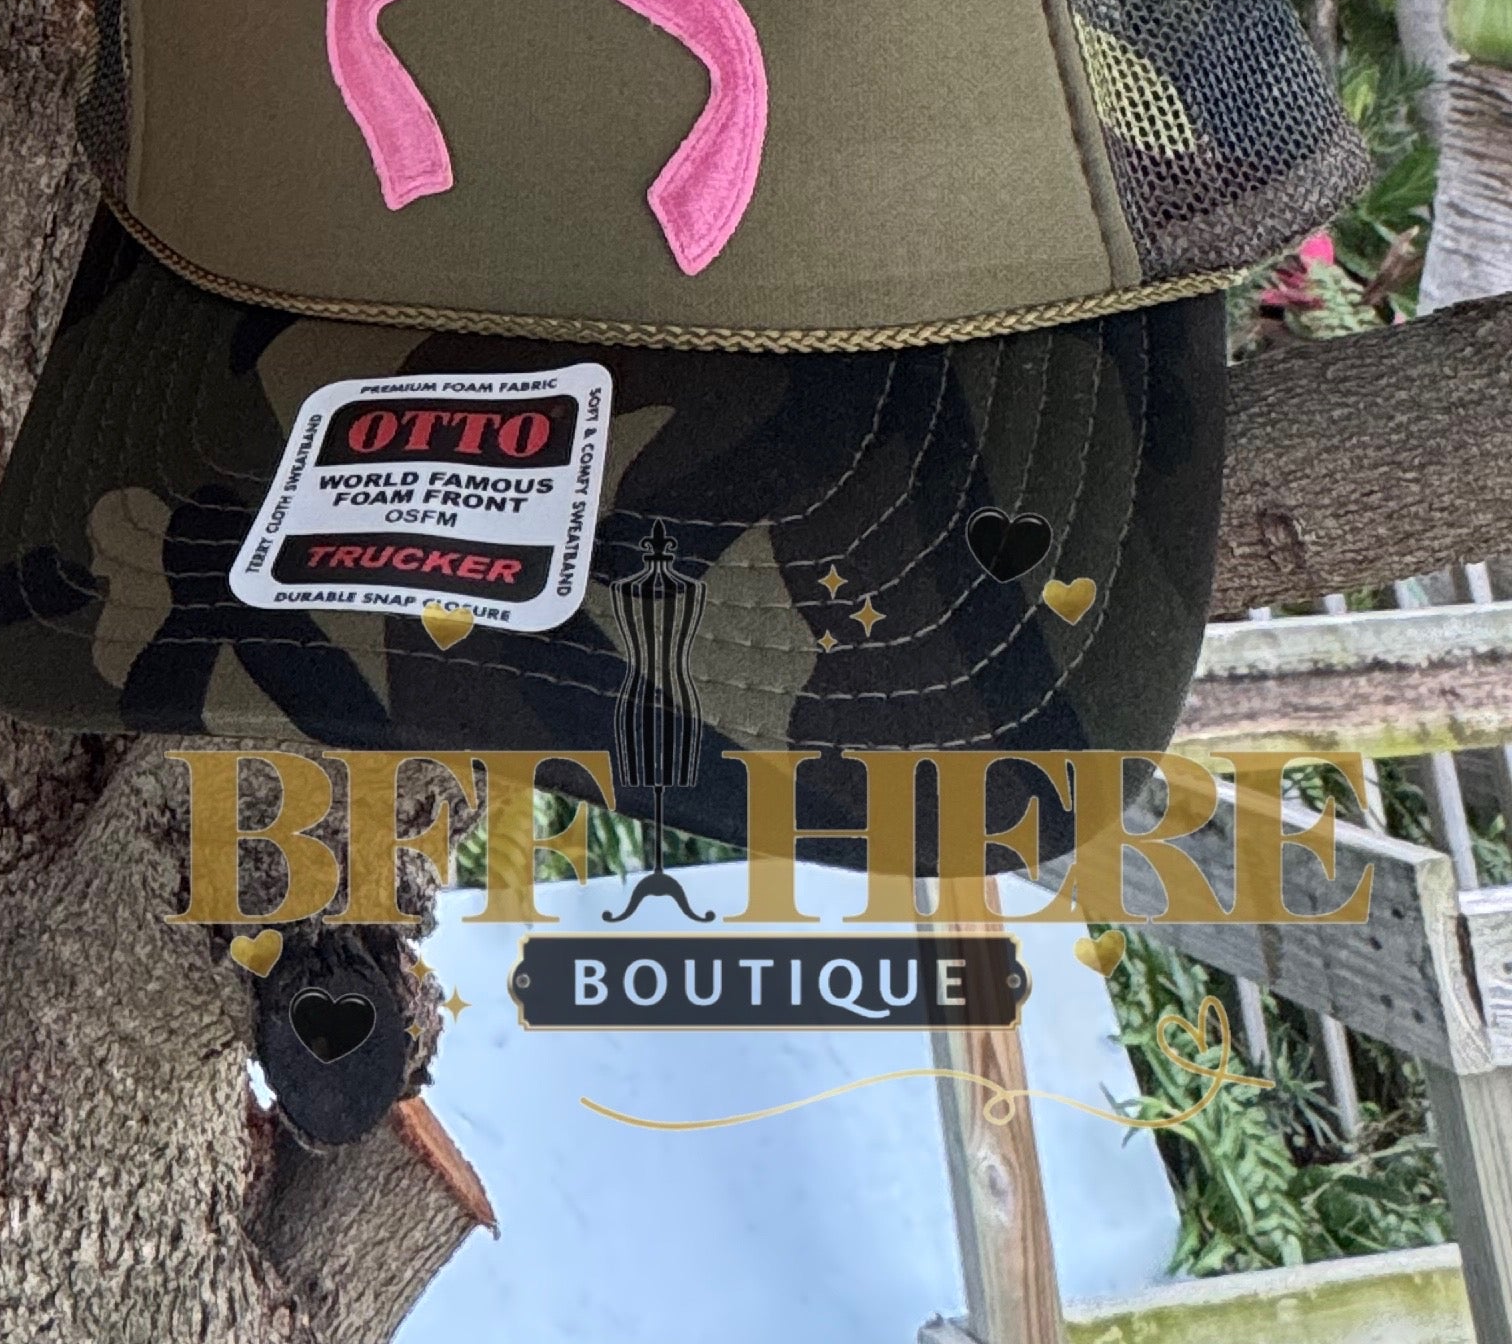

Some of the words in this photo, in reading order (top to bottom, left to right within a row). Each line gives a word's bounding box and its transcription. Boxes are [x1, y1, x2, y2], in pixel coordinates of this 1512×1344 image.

[360, 382, 436, 394] PREMIUM
[442, 382, 493, 393] FOAM
[499, 378, 558, 393] FABRIC
[586, 387, 601, 421] SOFT
[584, 428, 597, 439] &
[574, 444, 594, 495] COMFY
[246, 537, 273, 573] TERRY
[266, 495, 292, 533] CLOTH
[284, 414, 322, 491] SWEATBAND
[320, 472, 419, 490] WORLD
[428, 472, 554, 494] FAMOUS
[333, 490, 414, 507] FOAM
[423, 490, 528, 513] FRONT
[385, 509, 457, 528] OSFM
[557, 501, 586, 596] SWEATBAND
[306, 546, 523, 584] TRUCKER
[274, 592, 357, 604] DURABLE
[363, 593, 417, 608] SNAP
